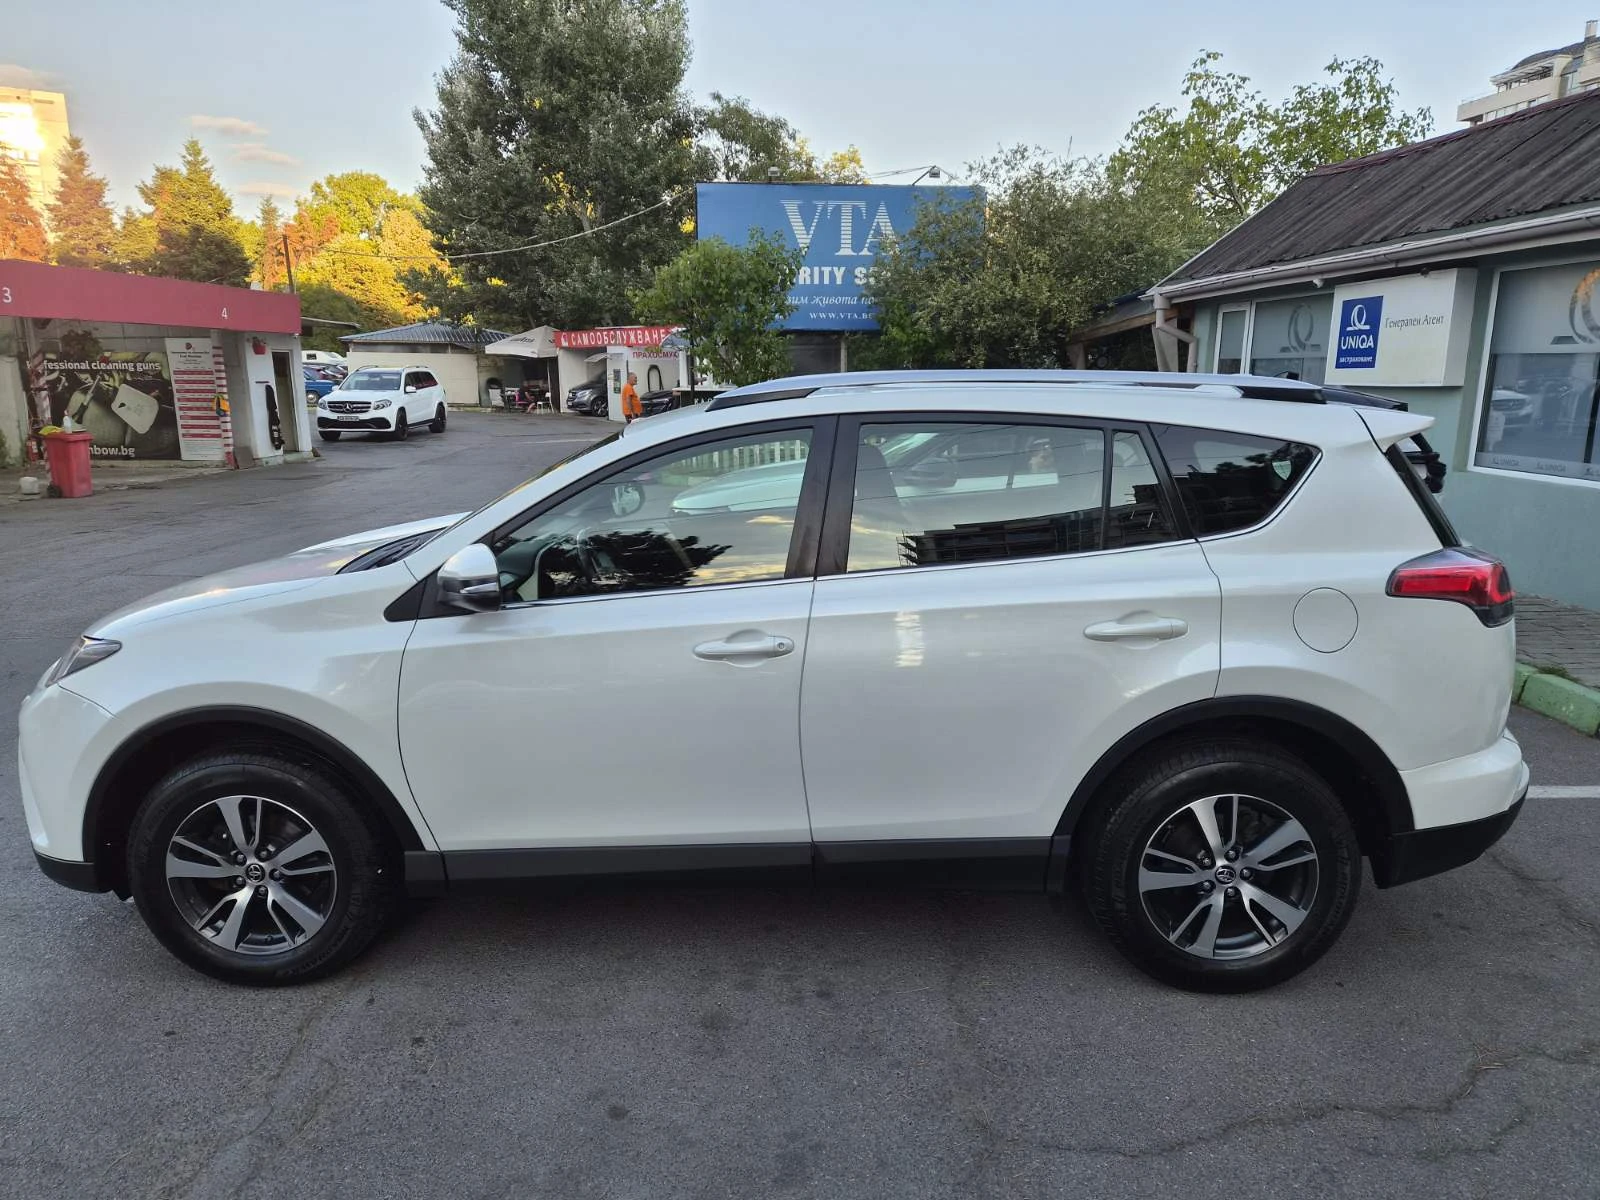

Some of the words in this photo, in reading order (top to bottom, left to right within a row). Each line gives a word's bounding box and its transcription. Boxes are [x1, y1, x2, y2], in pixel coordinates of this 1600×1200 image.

[779, 199, 900, 256] VTA
[796, 266, 846, 285] RITY
[2, 286, 12, 303] 3
[221, 307, 228, 320] 4
[1422, 314, 1445, 326] Агент
[571, 328, 667, 347] САМООБСЛУЖВАНЕ
[1340, 334, 1375, 350] UNIQA
[91, 359, 135, 372] cleaning
[136, 361, 161, 372] guns
[88, 444, 136, 458] nbow.bg
